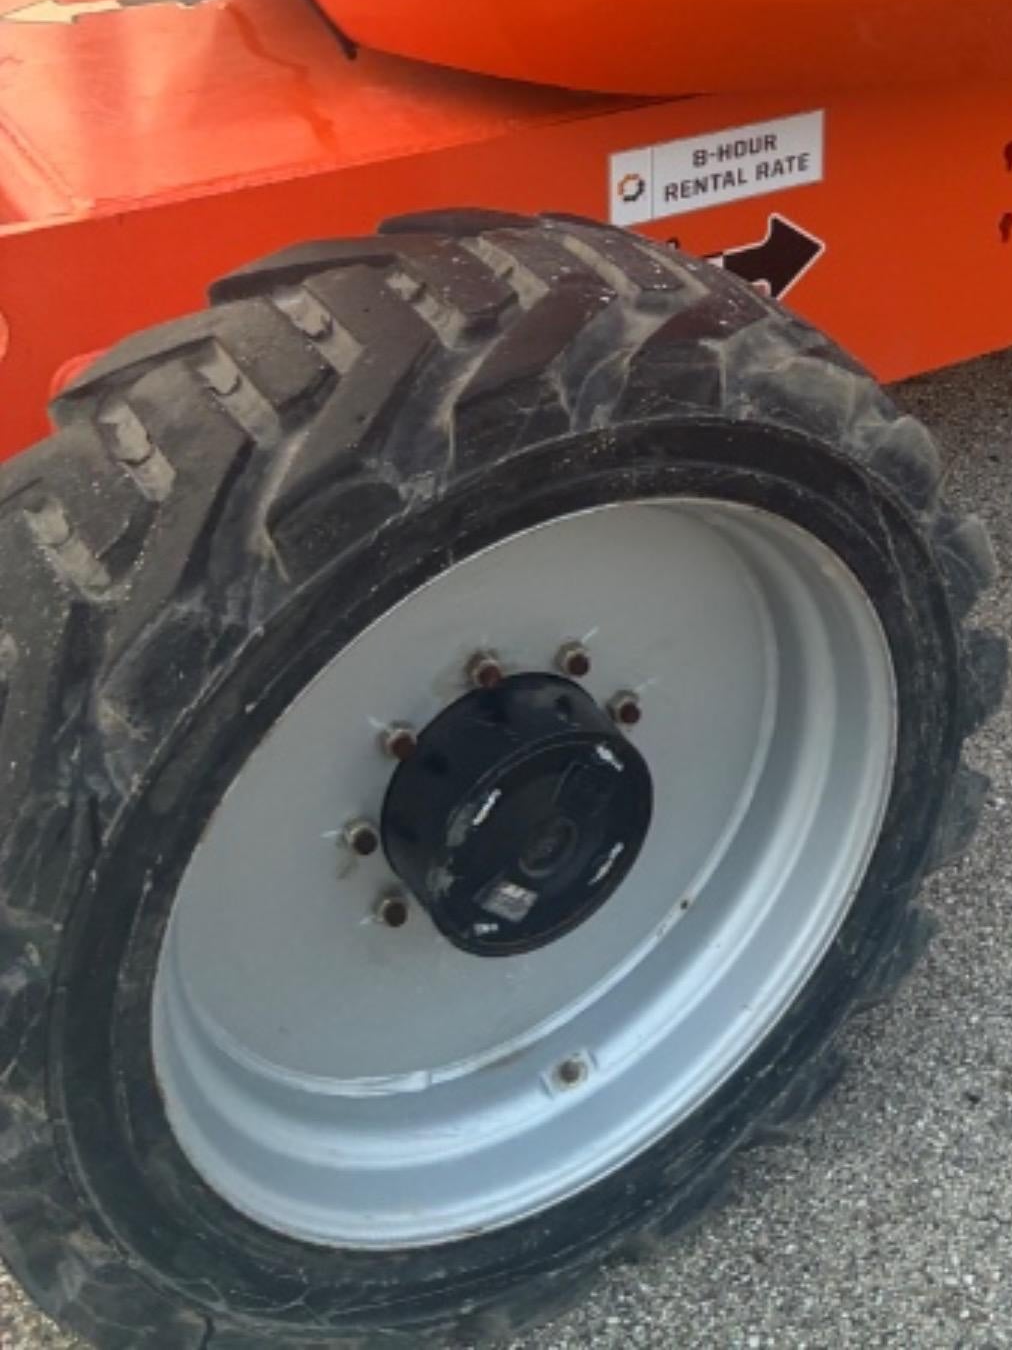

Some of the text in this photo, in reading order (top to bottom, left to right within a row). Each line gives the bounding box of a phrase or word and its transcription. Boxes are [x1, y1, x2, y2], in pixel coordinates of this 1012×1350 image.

[692, 134, 777, 167] 8-HOUR
[664, 152, 811, 202] RENTAL RATE
